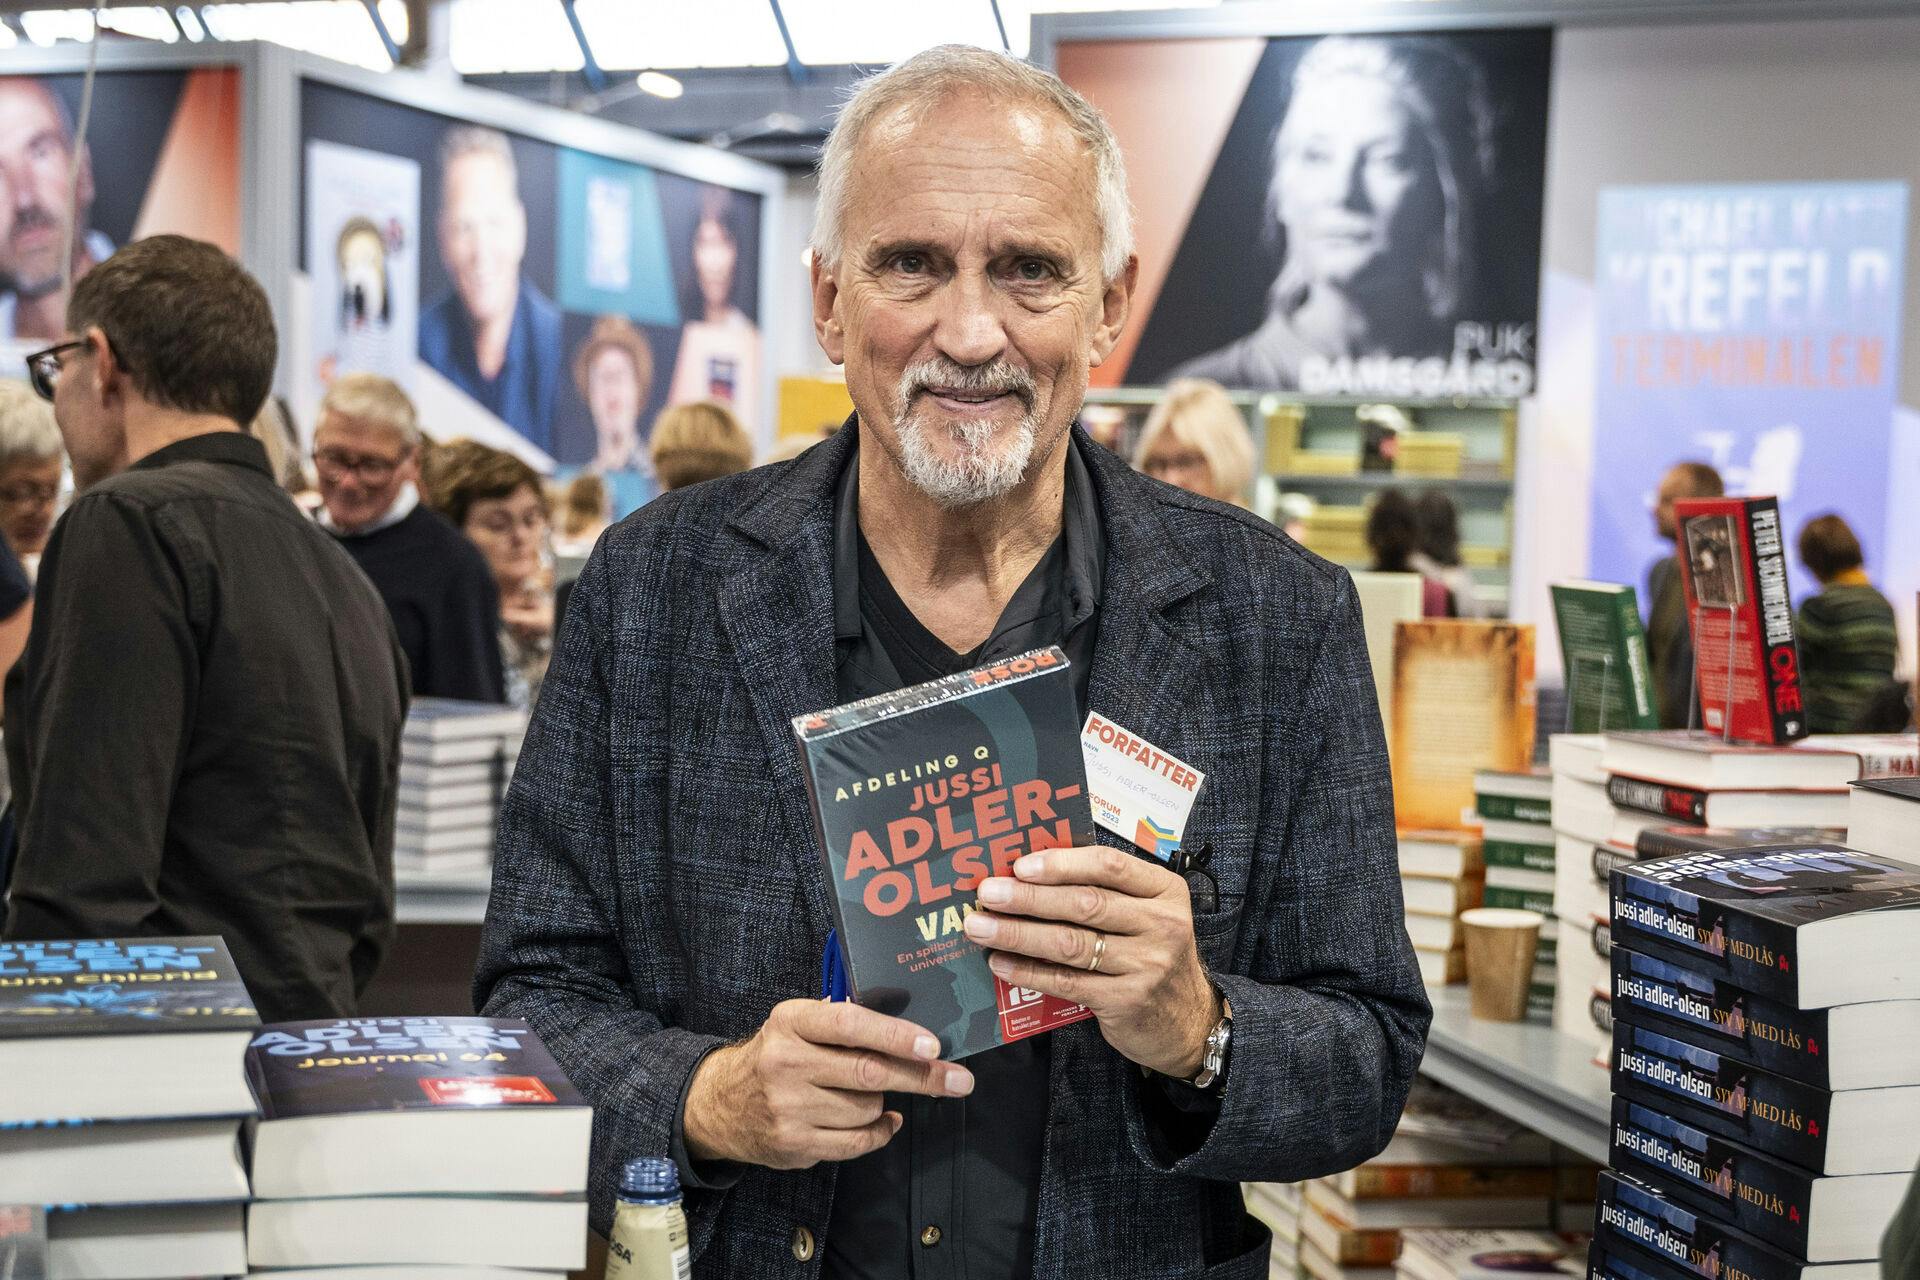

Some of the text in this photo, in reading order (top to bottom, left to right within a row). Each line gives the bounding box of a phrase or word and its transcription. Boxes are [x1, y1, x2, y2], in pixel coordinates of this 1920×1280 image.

[1769, 646, 1803, 715] ONE
[1083, 741, 1099, 753] NAVN
[1086, 717, 1198, 792] FORFATTER
[835, 745, 989, 802] AFDELING Q
[909, 763, 1004, 811] JUSSI
[844, 779, 1081, 881] ADLER-
[1101, 810, 1119, 824] 2023
[863, 818, 1073, 917] OLSEN
[1628, 852, 1726, 876] jussi
[1652, 850, 1870, 882] adler-olsen
[896, 952, 914, 964] En
[916, 938, 958, 958] spilbar
[1614, 895, 1637, 920] jussi
[1638, 905, 1695, 941] adler-olsen
[1730, 939, 1755, 960] MED
[1755, 941, 1775, 967] LÅS
[909, 948, 966, 972] universet
[251, 1025, 527, 1047] ADLER-
[1617, 974, 1643, 998] jussi
[1644, 984, 1710, 1020] adler-olsen
[1751, 1020, 1778, 1043] MED
[1780, 1024, 1801, 1050] LÅS
[268, 1037, 522, 1055] OLSEN
[298, 1052, 449, 1069] Journal
[1619, 1048, 1645, 1072] jussi
[1646, 1058, 1712, 1099] adler-olsen
[1752, 1099, 1780, 1122] MED
[1781, 1104, 1802, 1131] LÅS
[1615, 1123, 1640, 1150] jussi
[1641, 1133, 1701, 1178] adler-olsen
[1737, 1182, 1763, 1206] MED
[1764, 1189, 1784, 1216] LÅS
[1600, 1200, 1626, 1229] jussi
[1627, 1216, 1688, 1259] adler-olsen
